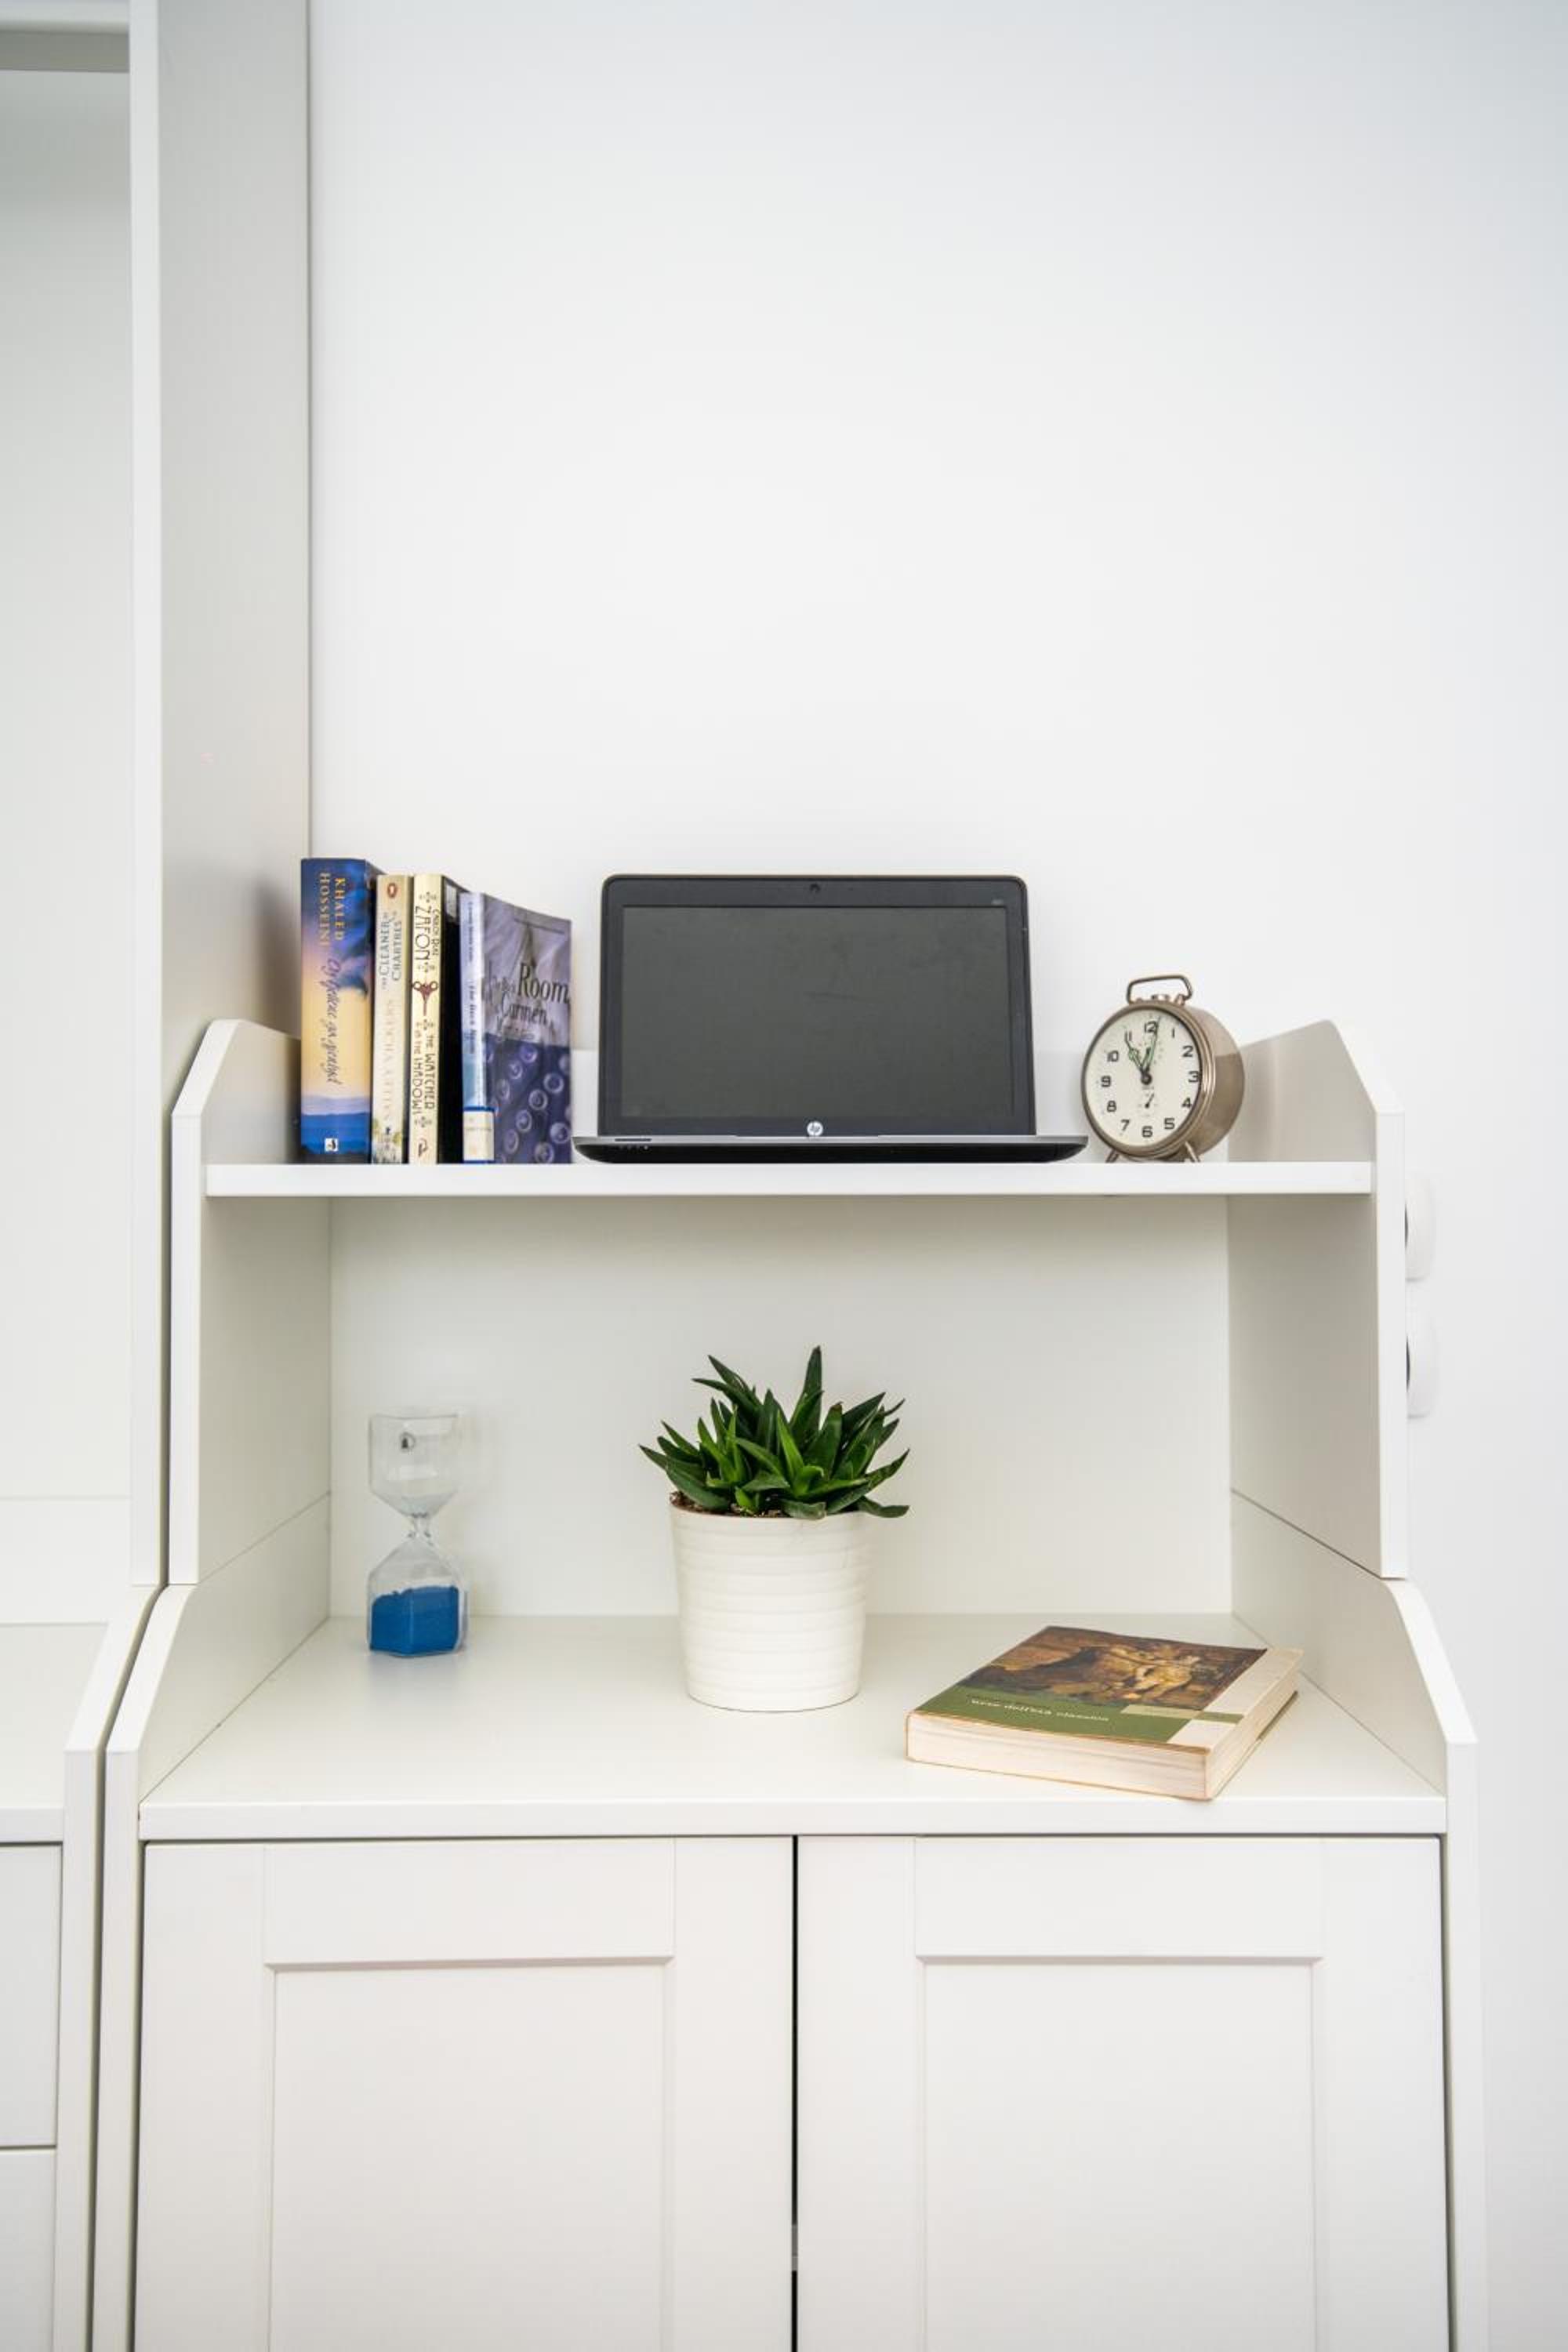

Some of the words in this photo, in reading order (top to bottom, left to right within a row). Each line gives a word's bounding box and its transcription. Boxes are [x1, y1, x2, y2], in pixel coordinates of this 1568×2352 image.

[319, 873, 331, 946] HOSSEINI
[334, 877, 346, 941] KHALED
[379, 921, 390, 976] CLEANER
[391, 920, 402, 982] CHARTRES
[321, 958, 341, 978] Og
[518, 963, 570, 1004] Room
[501, 991, 547, 1025] Carmen
[1144, 1021, 1158, 1033] 12
[1106, 1050, 1119, 1062] 10
[1182, 1045, 1194, 1058] 2
[425, 1053, 436, 1109] WATCHER
[1101, 1076, 1112, 1087] 9
[1188, 1071, 1200, 1083] 3
[1106, 1100, 1117, 1112] 8
[1181, 1098, 1192, 1109] 4
[1120, 1120, 1131, 1131] 7
[1163, 1118, 1175, 1130] 5
[1142, 1126, 1153, 1138] 6
